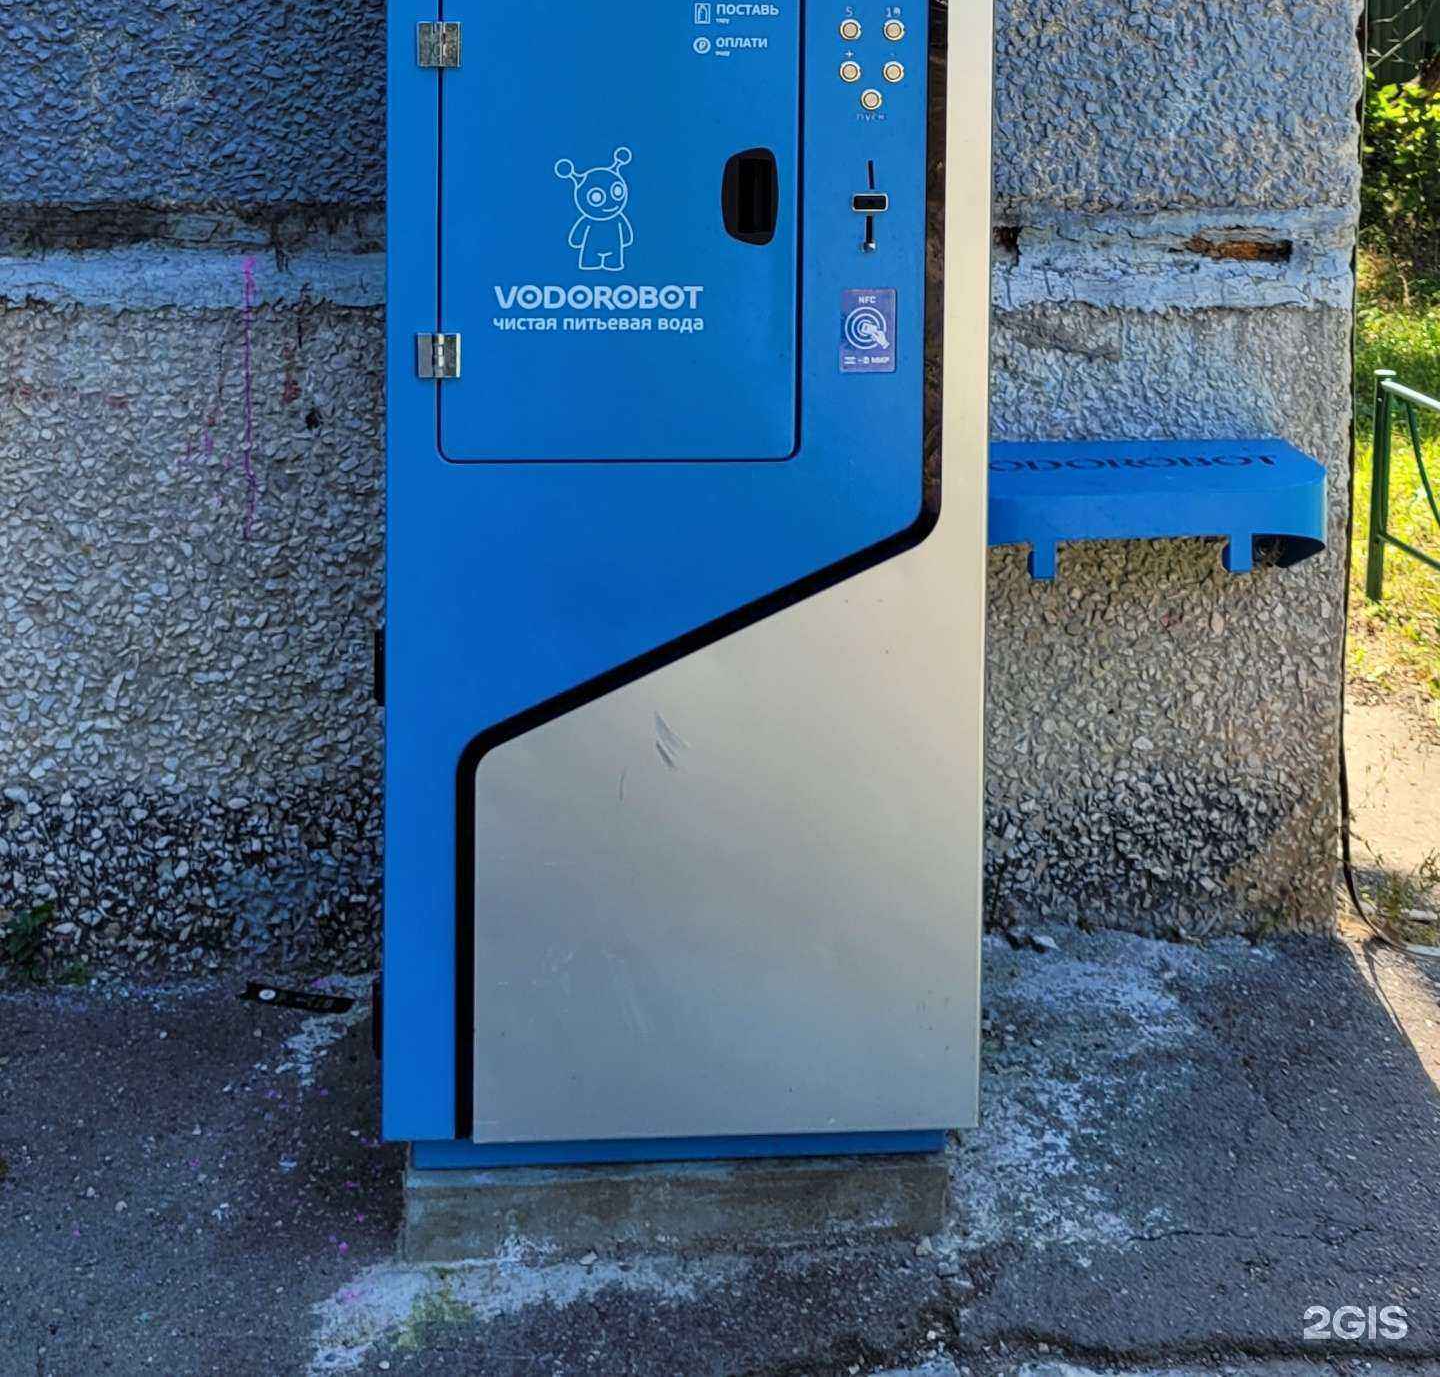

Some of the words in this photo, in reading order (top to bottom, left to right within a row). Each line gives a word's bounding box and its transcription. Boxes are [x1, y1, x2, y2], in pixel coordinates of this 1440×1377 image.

[716, 4, 779, 16] ПОСТАВЬ
[715, 37, 768, 48] ОПЛАТИ
[494, 285, 704, 311] VODOROBOT
[859, 295, 877, 304] NFC
[493, 317, 557, 331] чистая
[563, 317, 652, 331] питьевая
[658, 318, 704, 333] вода
